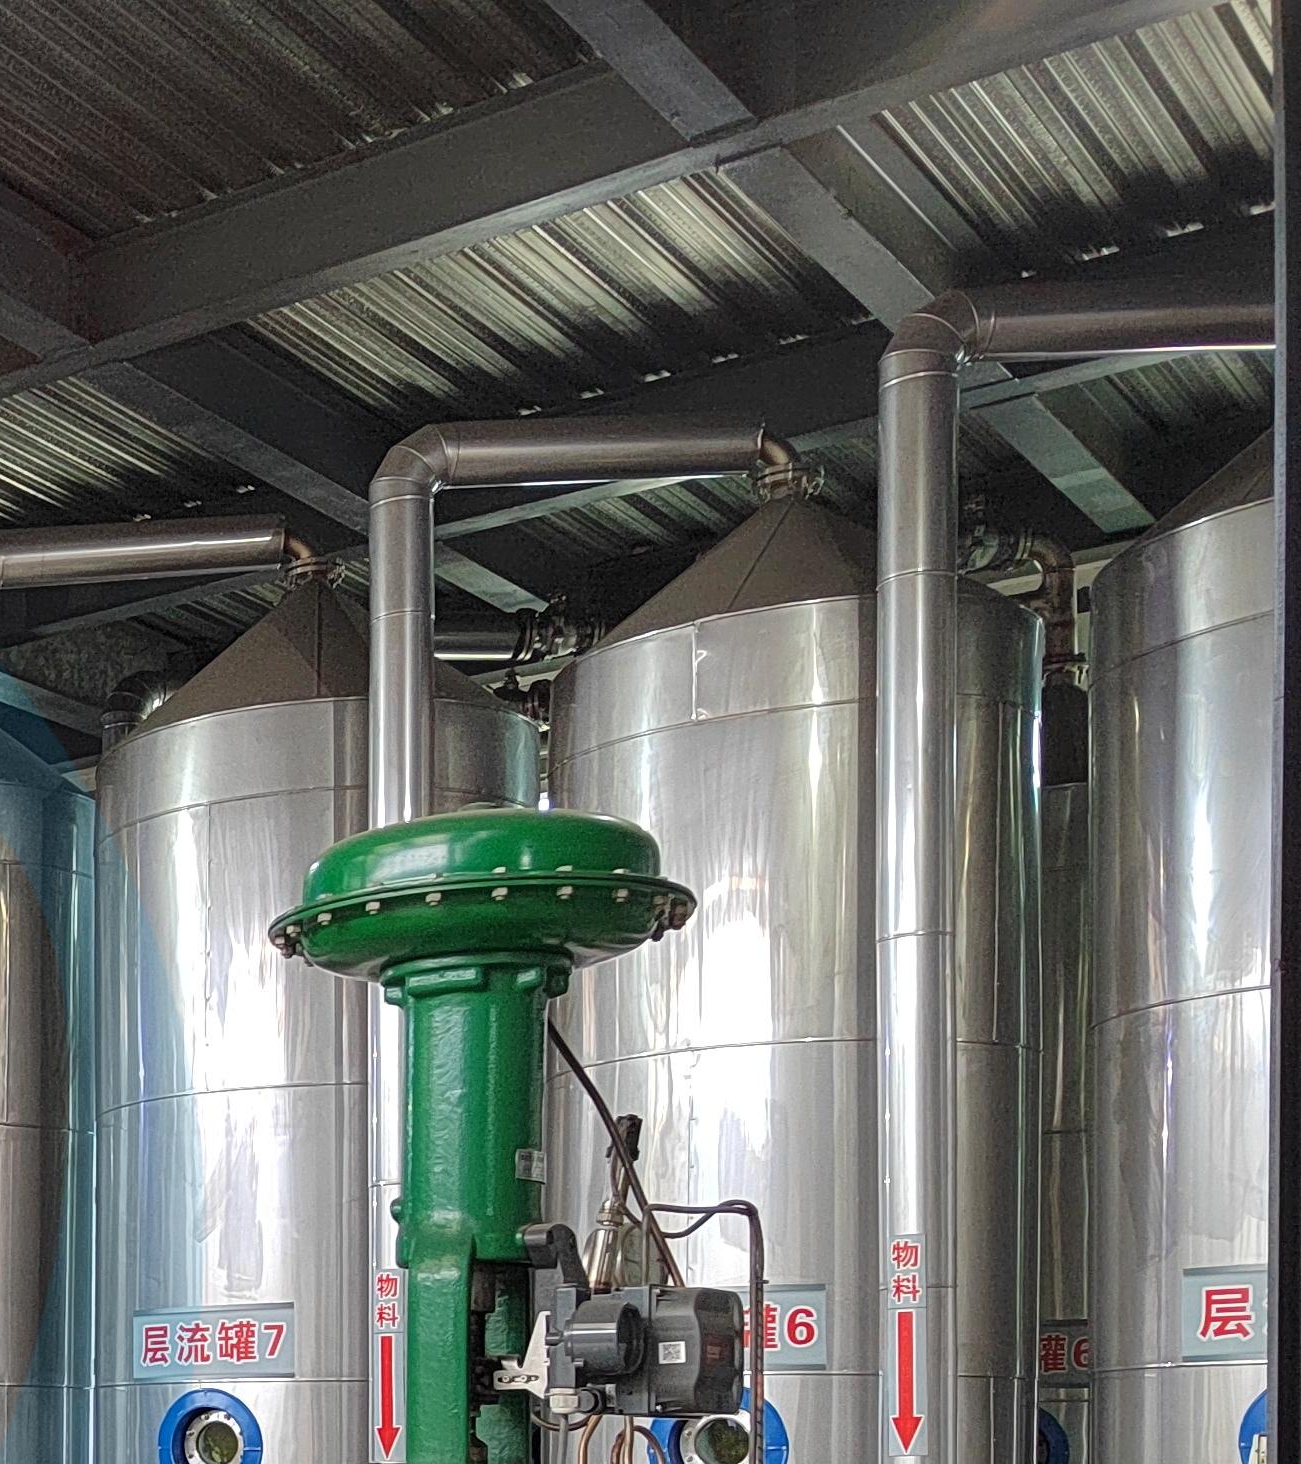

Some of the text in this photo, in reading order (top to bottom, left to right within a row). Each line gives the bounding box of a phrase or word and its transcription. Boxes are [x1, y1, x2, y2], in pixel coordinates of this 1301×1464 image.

[890, 1241, 920, 1302] 物料
[376, 1274, 398, 1328] 物料
[142, 1321, 284, 1364] 层流罐7
